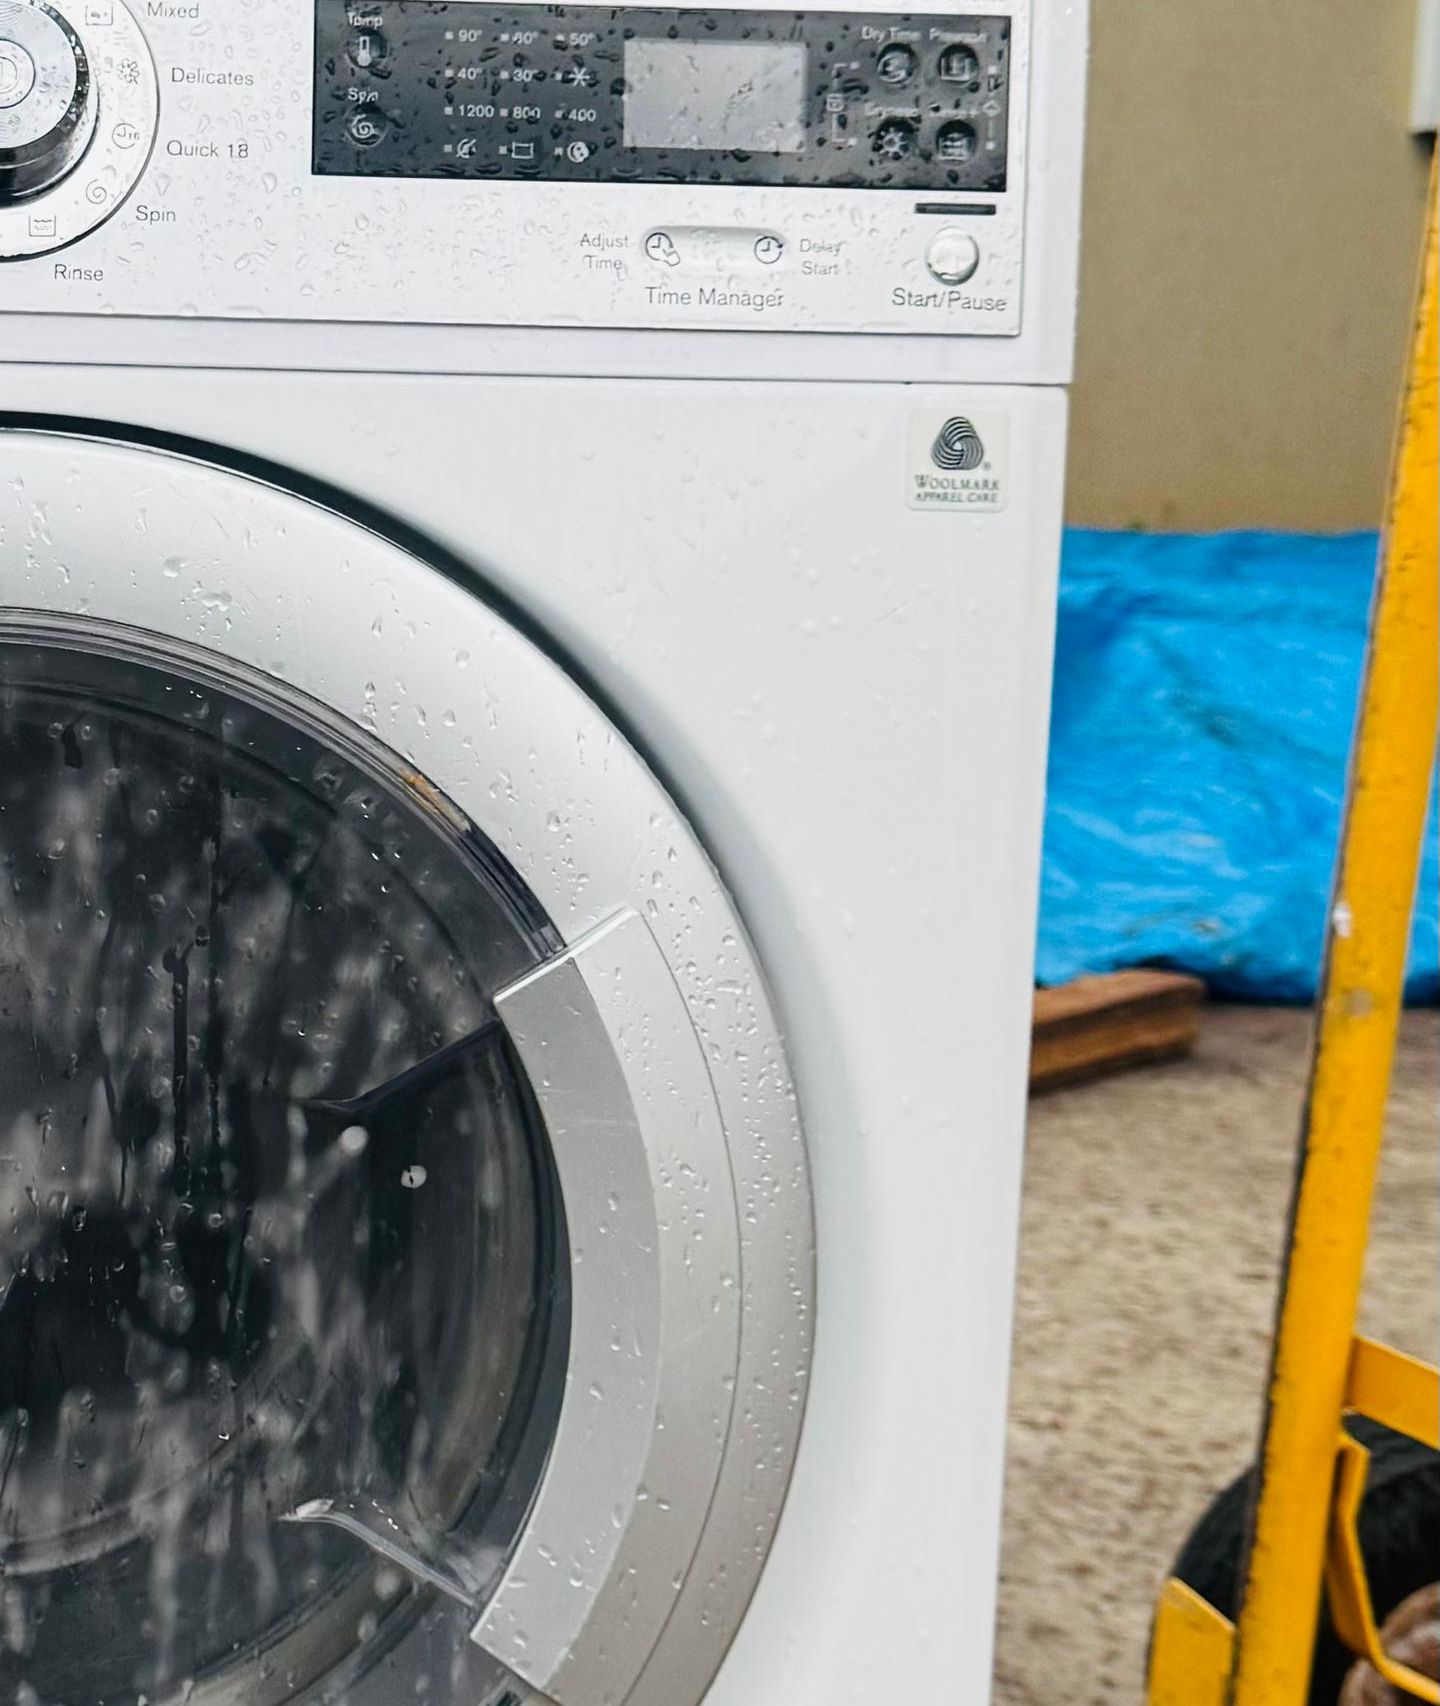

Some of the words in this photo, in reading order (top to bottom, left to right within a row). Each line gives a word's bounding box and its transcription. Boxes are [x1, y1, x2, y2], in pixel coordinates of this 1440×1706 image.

[147, 1, 200, 19] Mixed
[171, 67, 254, 86] Delicates
[458, 104, 494, 118] 1200
[568, 109, 596, 123] 400
[166, 139, 219, 158] Quick
[227, 143, 249, 159] 18
[135, 204, 176, 225] Spin
[579, 232, 629, 250] Adjust
[799, 238, 843, 256] Delay
[586, 255, 623, 270] Time
[801, 260, 839, 276] Start
[54, 263, 104, 281] Rinse
[645, 286, 692, 306] Time
[698, 287, 785, 310] Manager
[891, 287, 1008, 313] Start/Pause
[915, 475, 1000, 491] WOOLMARK
